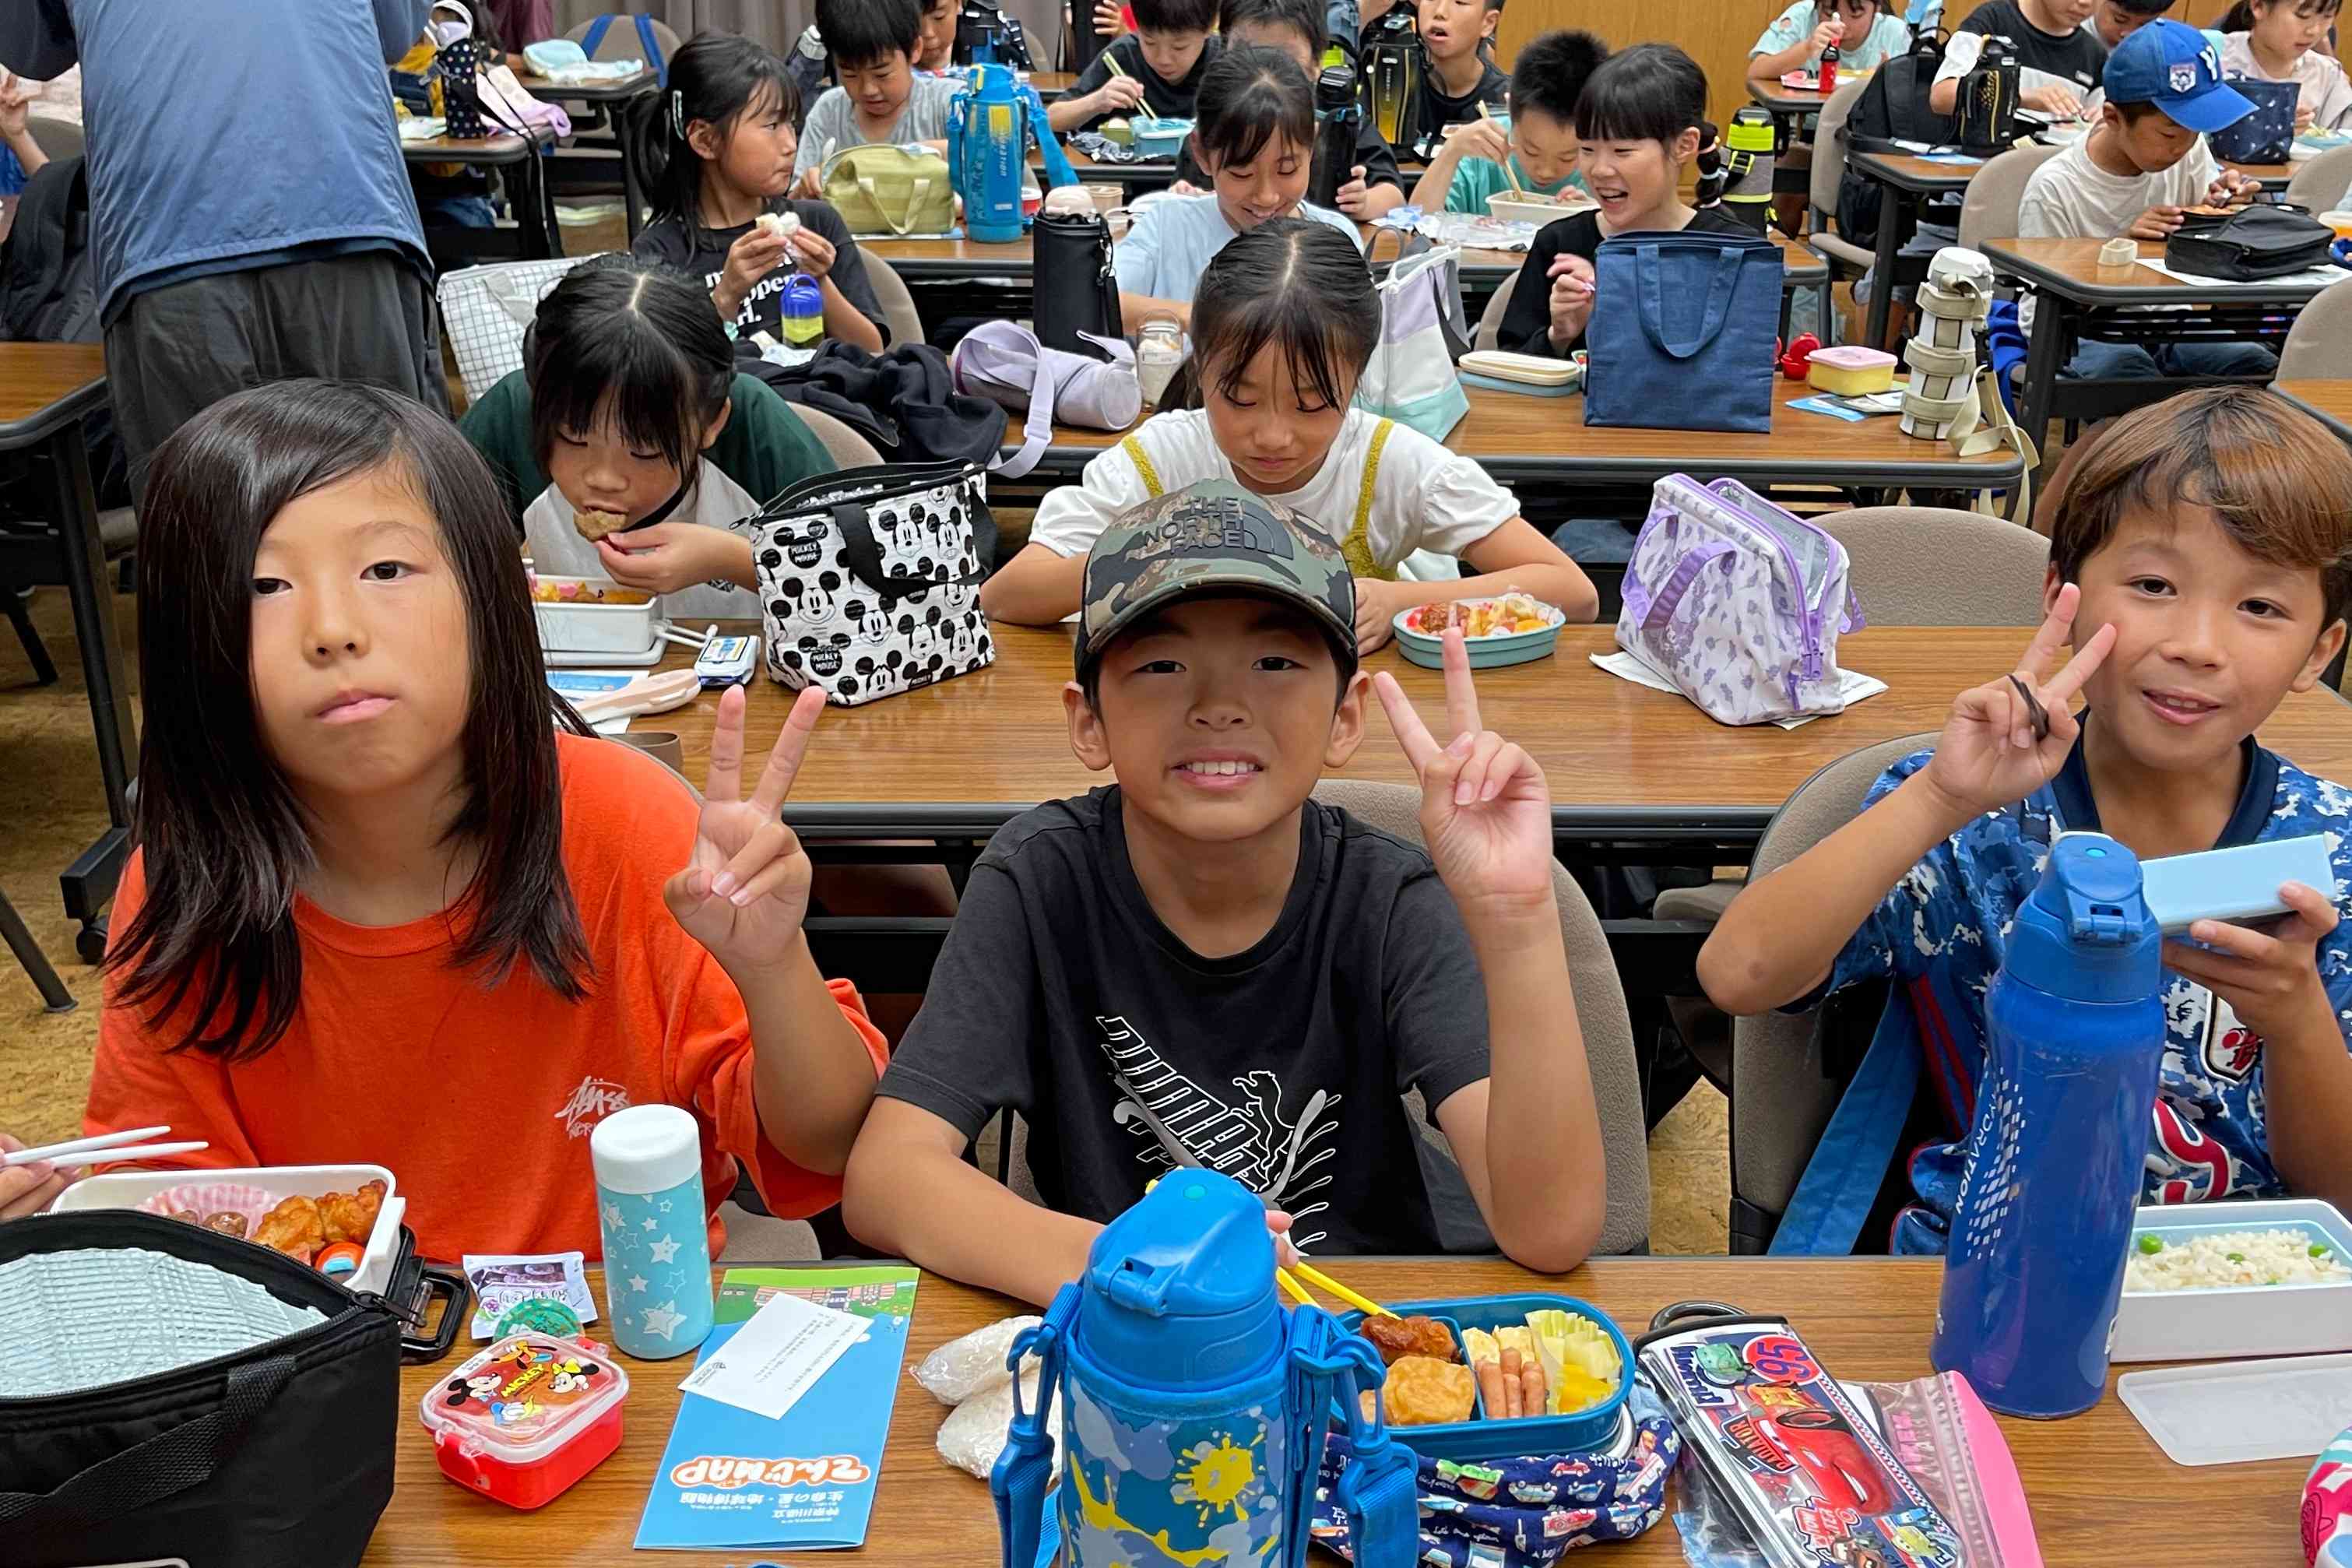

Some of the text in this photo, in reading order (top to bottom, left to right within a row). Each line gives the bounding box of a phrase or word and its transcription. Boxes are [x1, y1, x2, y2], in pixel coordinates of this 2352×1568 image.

[1190, 496, 1240, 514] THE
[1144, 512, 1243, 543] NORTH
[1170, 529, 1244, 554] FACE
[1756, 1342, 1812, 1379] 95
[500, 1363, 544, 1397] MICKEY
[1728, 1419, 1790, 1470] RADIATOR
[676, 1457, 863, 1483] てんじMAP
